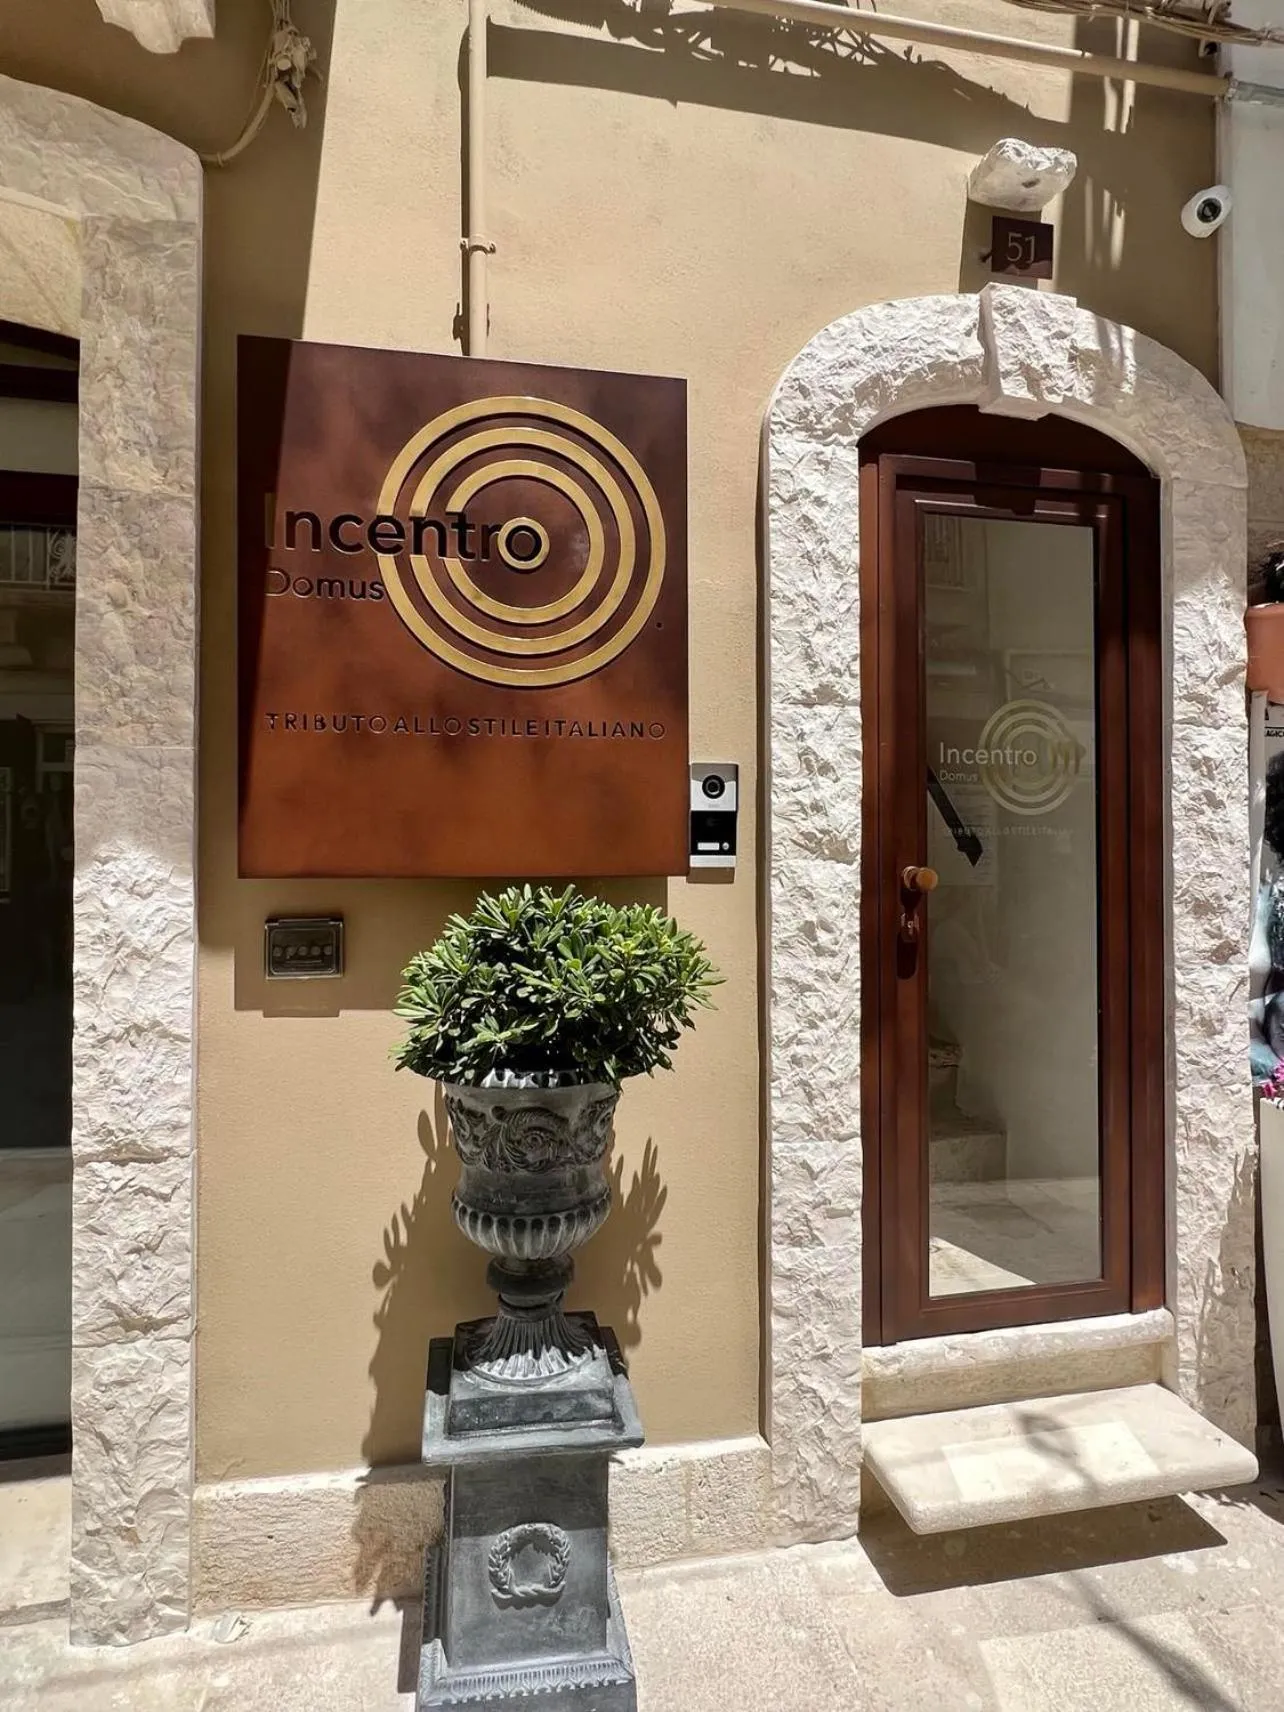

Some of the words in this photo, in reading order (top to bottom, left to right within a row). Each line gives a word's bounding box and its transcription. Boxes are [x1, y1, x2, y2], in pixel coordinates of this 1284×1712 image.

[1006, 231, 1036, 264] 51
[264, 491, 543, 563] Incentro
[263, 566, 385, 602] Domus
[939, 741, 1038, 766] Incentro
[939, 769, 978, 782] Domus
